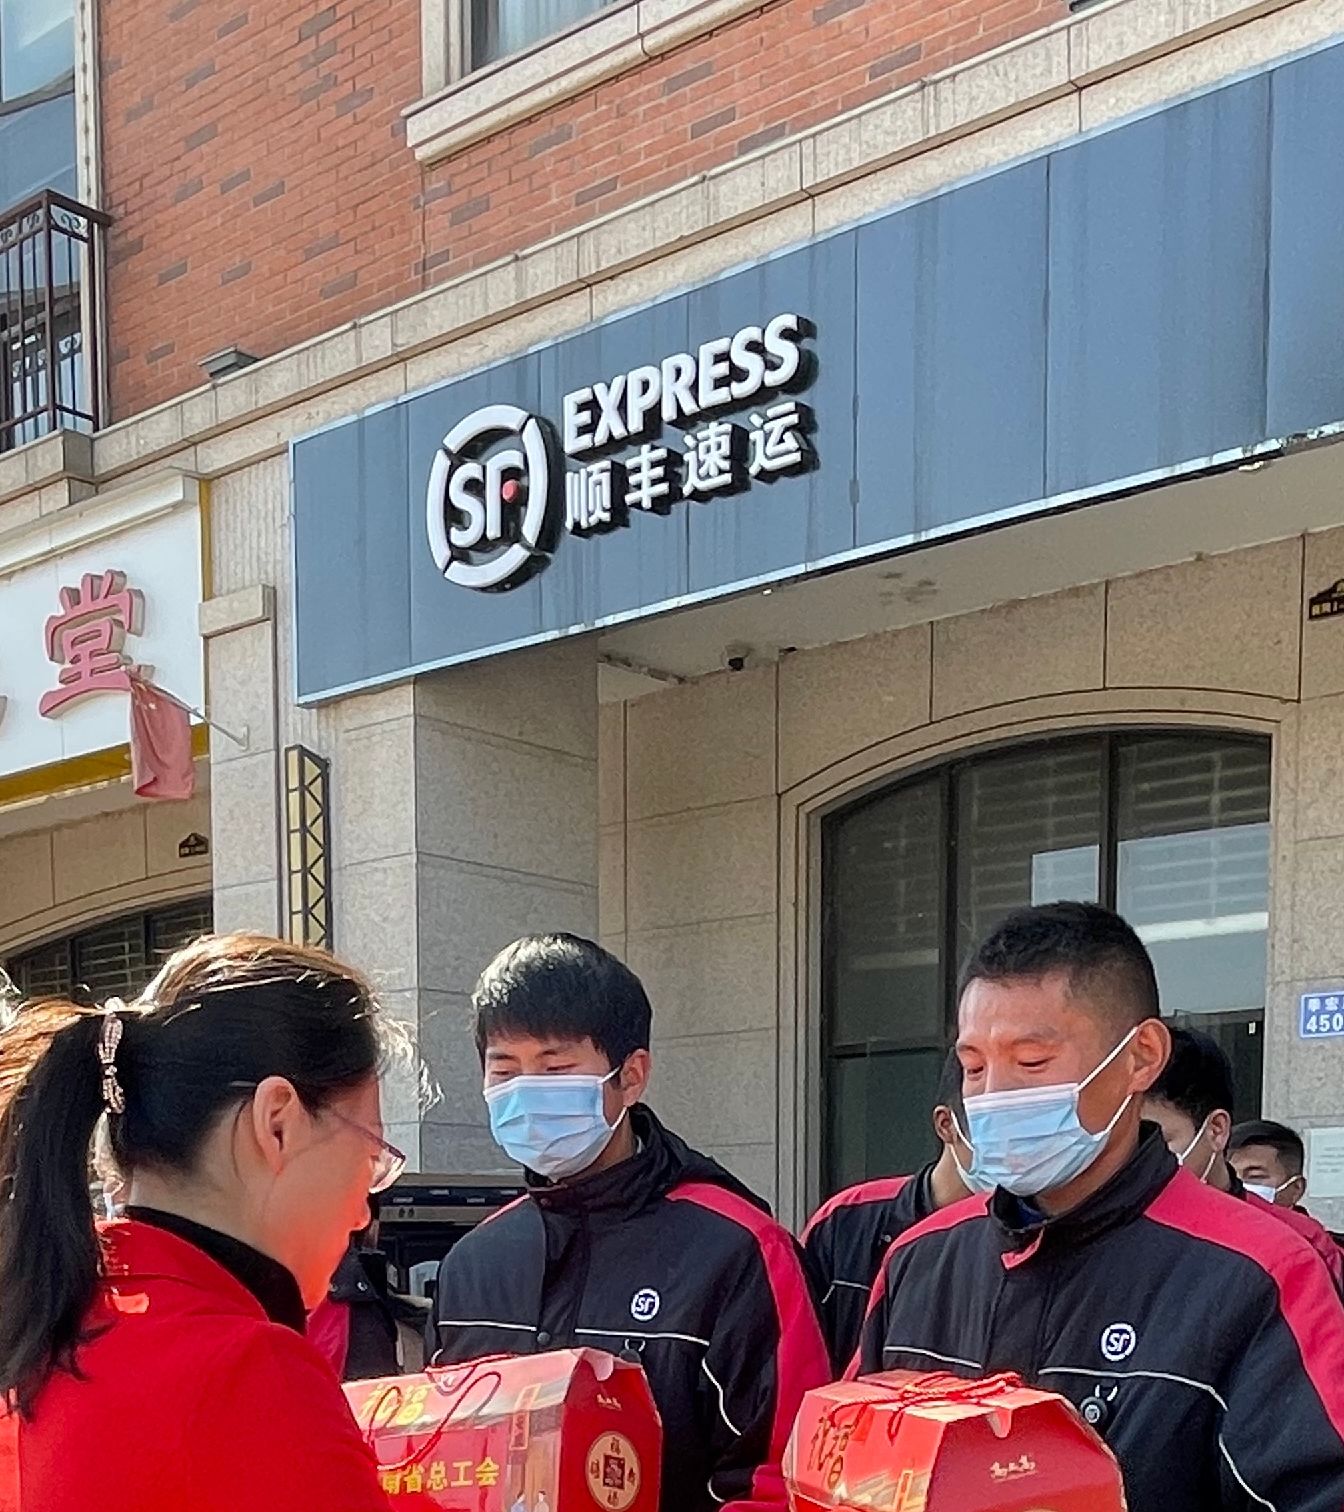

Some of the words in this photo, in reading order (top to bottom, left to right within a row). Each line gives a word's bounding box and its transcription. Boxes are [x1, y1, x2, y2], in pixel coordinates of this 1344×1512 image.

[563, 312, 803, 455] EXPRESS
[565, 401, 803, 530] 顺丰速运
